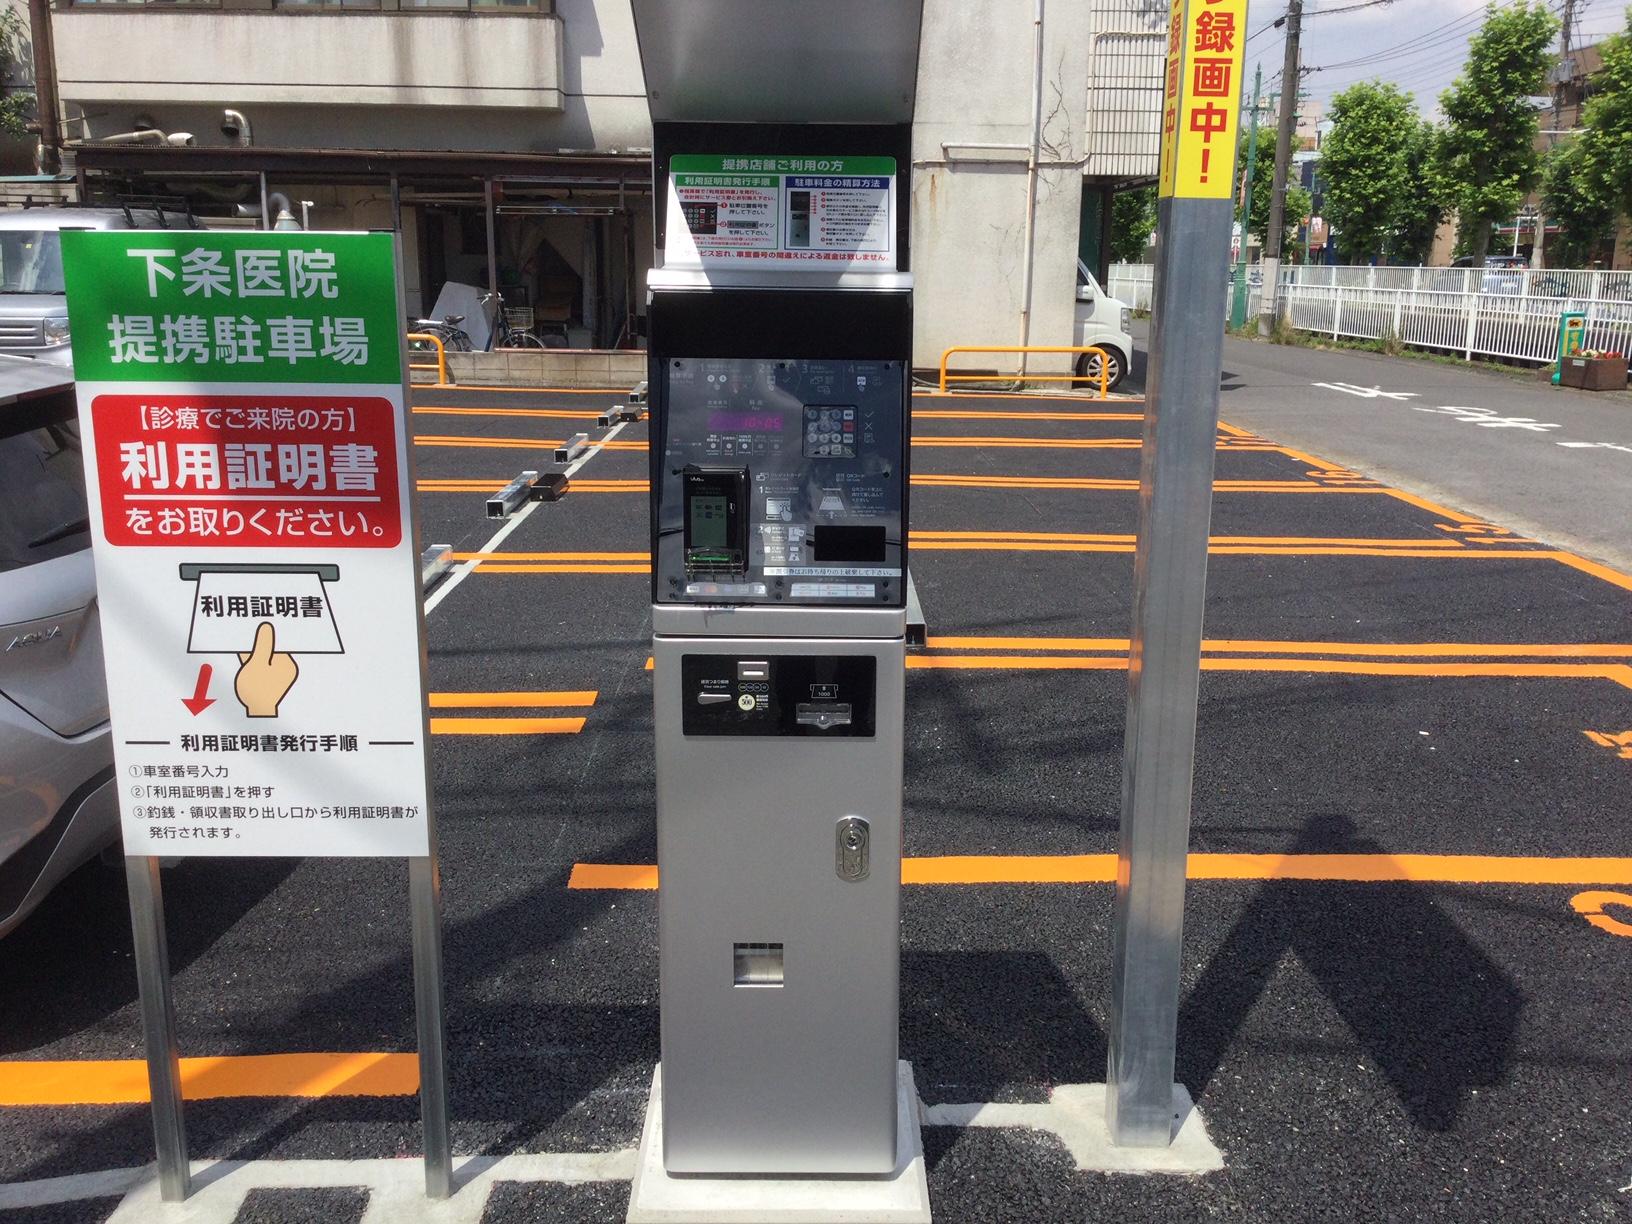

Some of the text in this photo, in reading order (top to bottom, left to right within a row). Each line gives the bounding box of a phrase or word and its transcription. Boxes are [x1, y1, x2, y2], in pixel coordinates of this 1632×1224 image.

[1165, 0, 1182, 184] 録画中!
[1190, 0, 1235, 184] 録画中!
[722, 158, 844, 172] 提携店舗ご利用の方
[684, 176, 771, 186] 利用証明書発行手順
[794, 178, 881, 188] 駐車料金の精算方法
[126, 248, 339, 299] 下条医院
[107, 314, 369, 366] 提携駐車場
[138, 406, 357, 431] 【診療でご来院の方】
[119, 440, 379, 491] 利用証明書
[125, 507, 384, 537] をお取りください。
[200, 594, 324, 619] 利用証明書
[180, 733, 359, 753] 利用証明書発行手順
[128, 764, 229, 779] ①車室番号入力
[149, 826, 242, 840] 発行されます。
